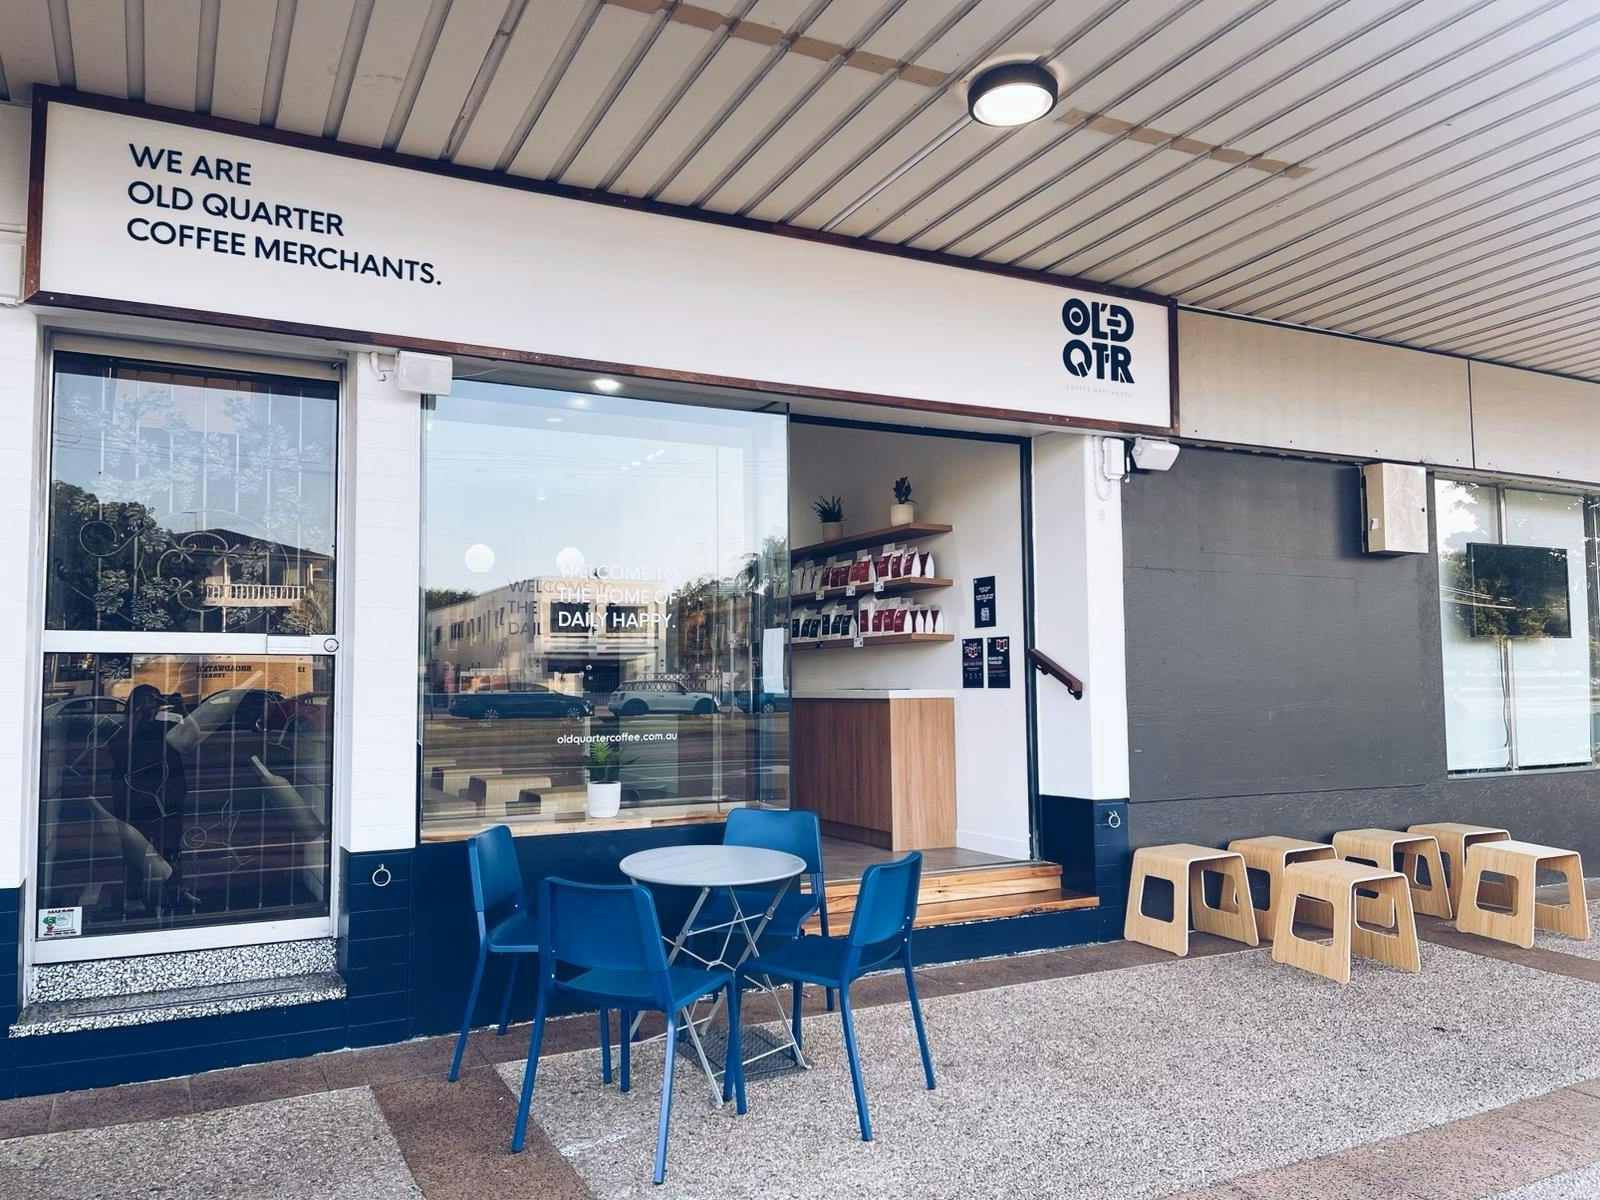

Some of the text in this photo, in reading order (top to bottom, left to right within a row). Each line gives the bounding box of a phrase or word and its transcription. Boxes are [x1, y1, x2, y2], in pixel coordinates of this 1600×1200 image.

[128, 143, 252, 186] WE ARE
[127, 181, 344, 236] OLD QUARTER
[126, 217, 442, 286] COFFEE MERCHANTS.
[1062, 339, 1135, 384] QTR
[560, 562, 678, 581] WELCOME TO
[559, 587, 678, 605] THE HOME OF
[558, 611, 676, 629] DAILY HAPPY.
[556, 731, 678, 746] oldquartercoffee.com.au
